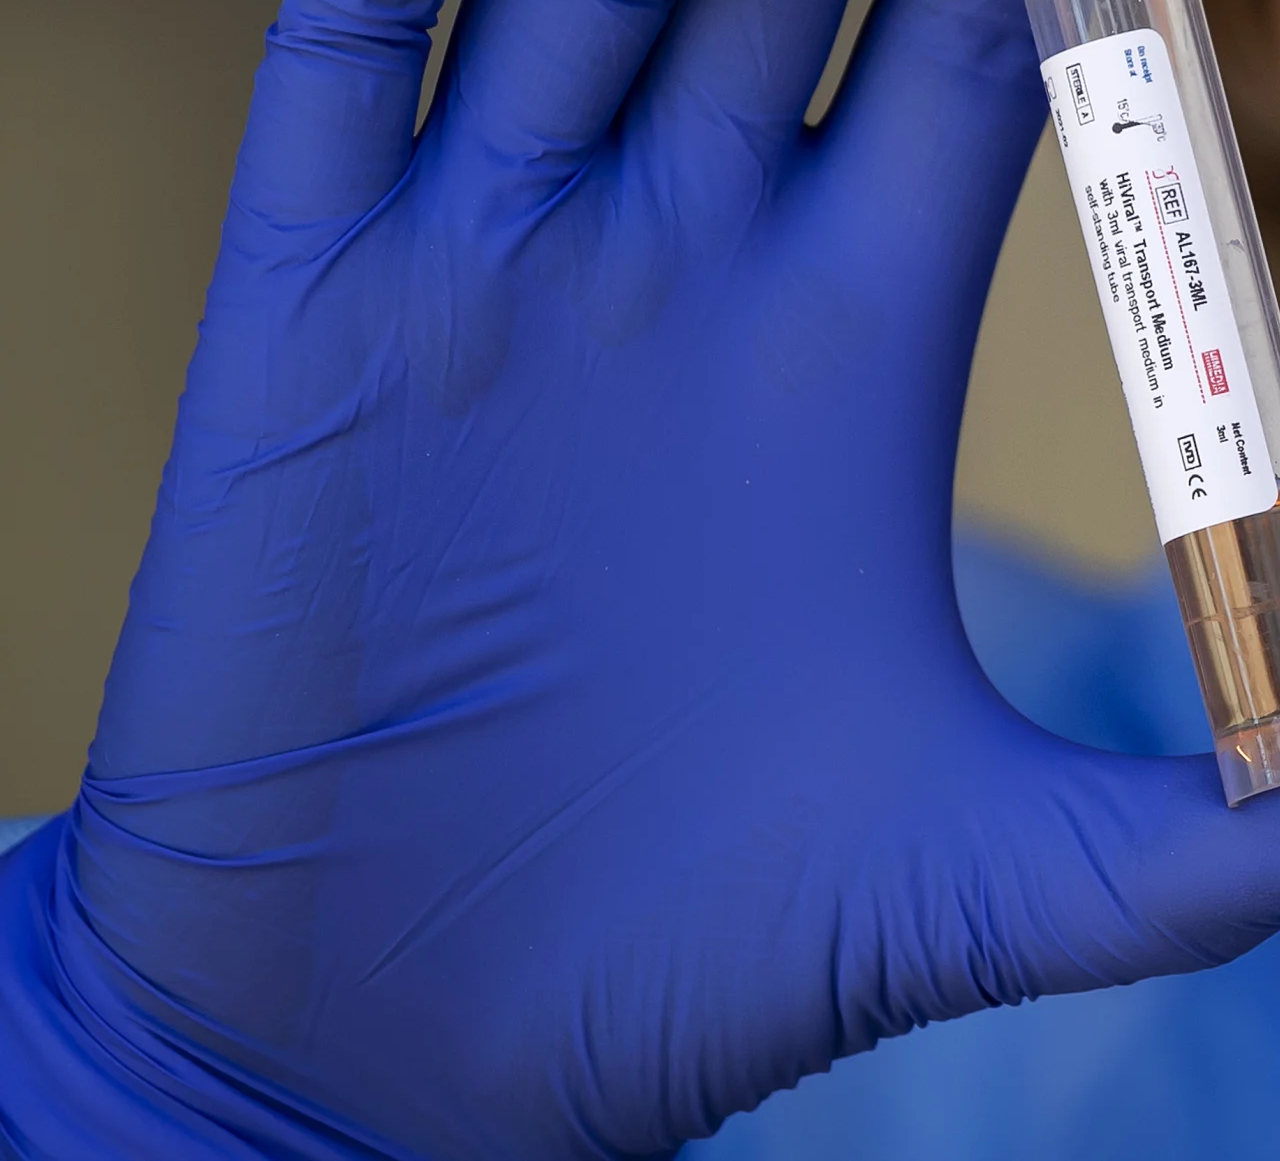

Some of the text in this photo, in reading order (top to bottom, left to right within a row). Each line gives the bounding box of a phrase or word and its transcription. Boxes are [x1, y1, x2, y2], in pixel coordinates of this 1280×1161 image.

[1084, 185, 1120, 303] self-standing tube
[1099, 178, 1165, 409] with 3ml viral transport medium in
[1133, 238, 1162, 311] Transport
[1151, 312, 1174, 371] Medium
[1161, 188, 1208, 312] REF AL167-3ML
[1216, 424, 1229, 443] 3ml
[1231, 422, 1252, 476] Net Content
